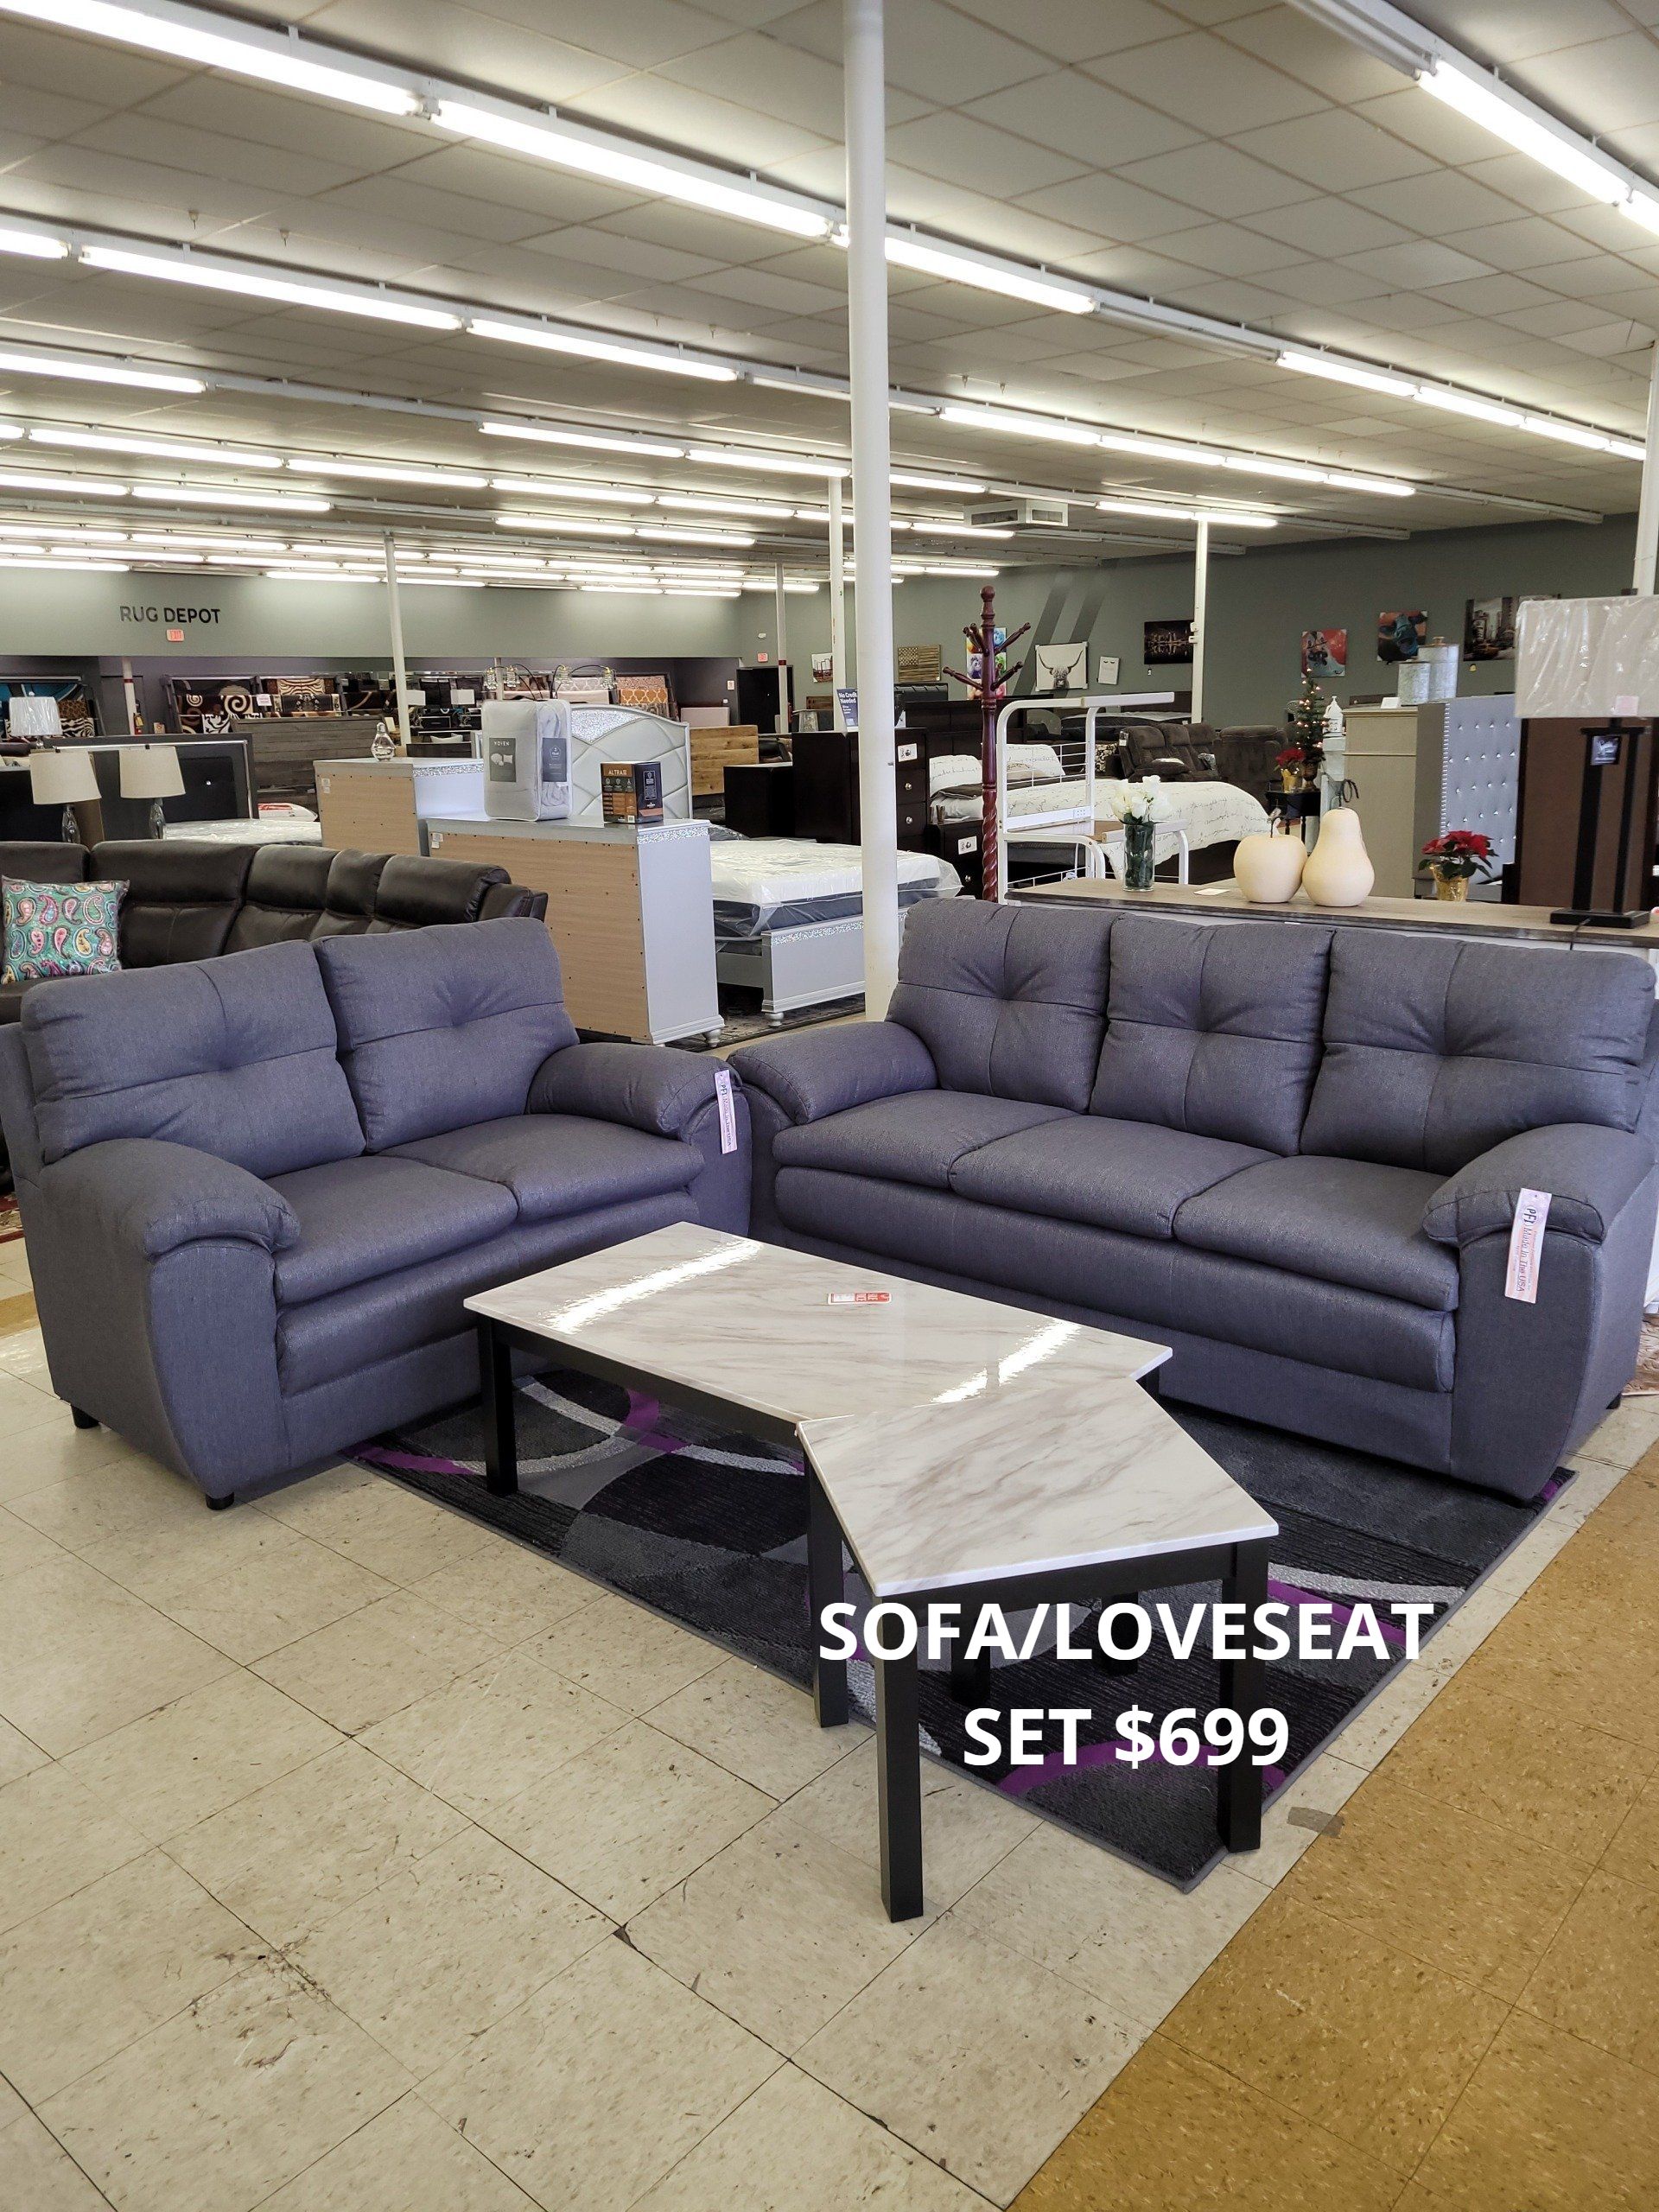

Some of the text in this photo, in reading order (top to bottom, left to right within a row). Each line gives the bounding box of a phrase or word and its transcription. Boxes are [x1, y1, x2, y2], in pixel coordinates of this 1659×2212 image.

[120, 606, 220, 623] RUG DEPOT
[1523, 1208, 1536, 1224] PFI
[1522, 1227, 1532, 1248] Made
[1519, 1261, 1528, 1274] The
[1516, 1275, 1526, 1292] USA
